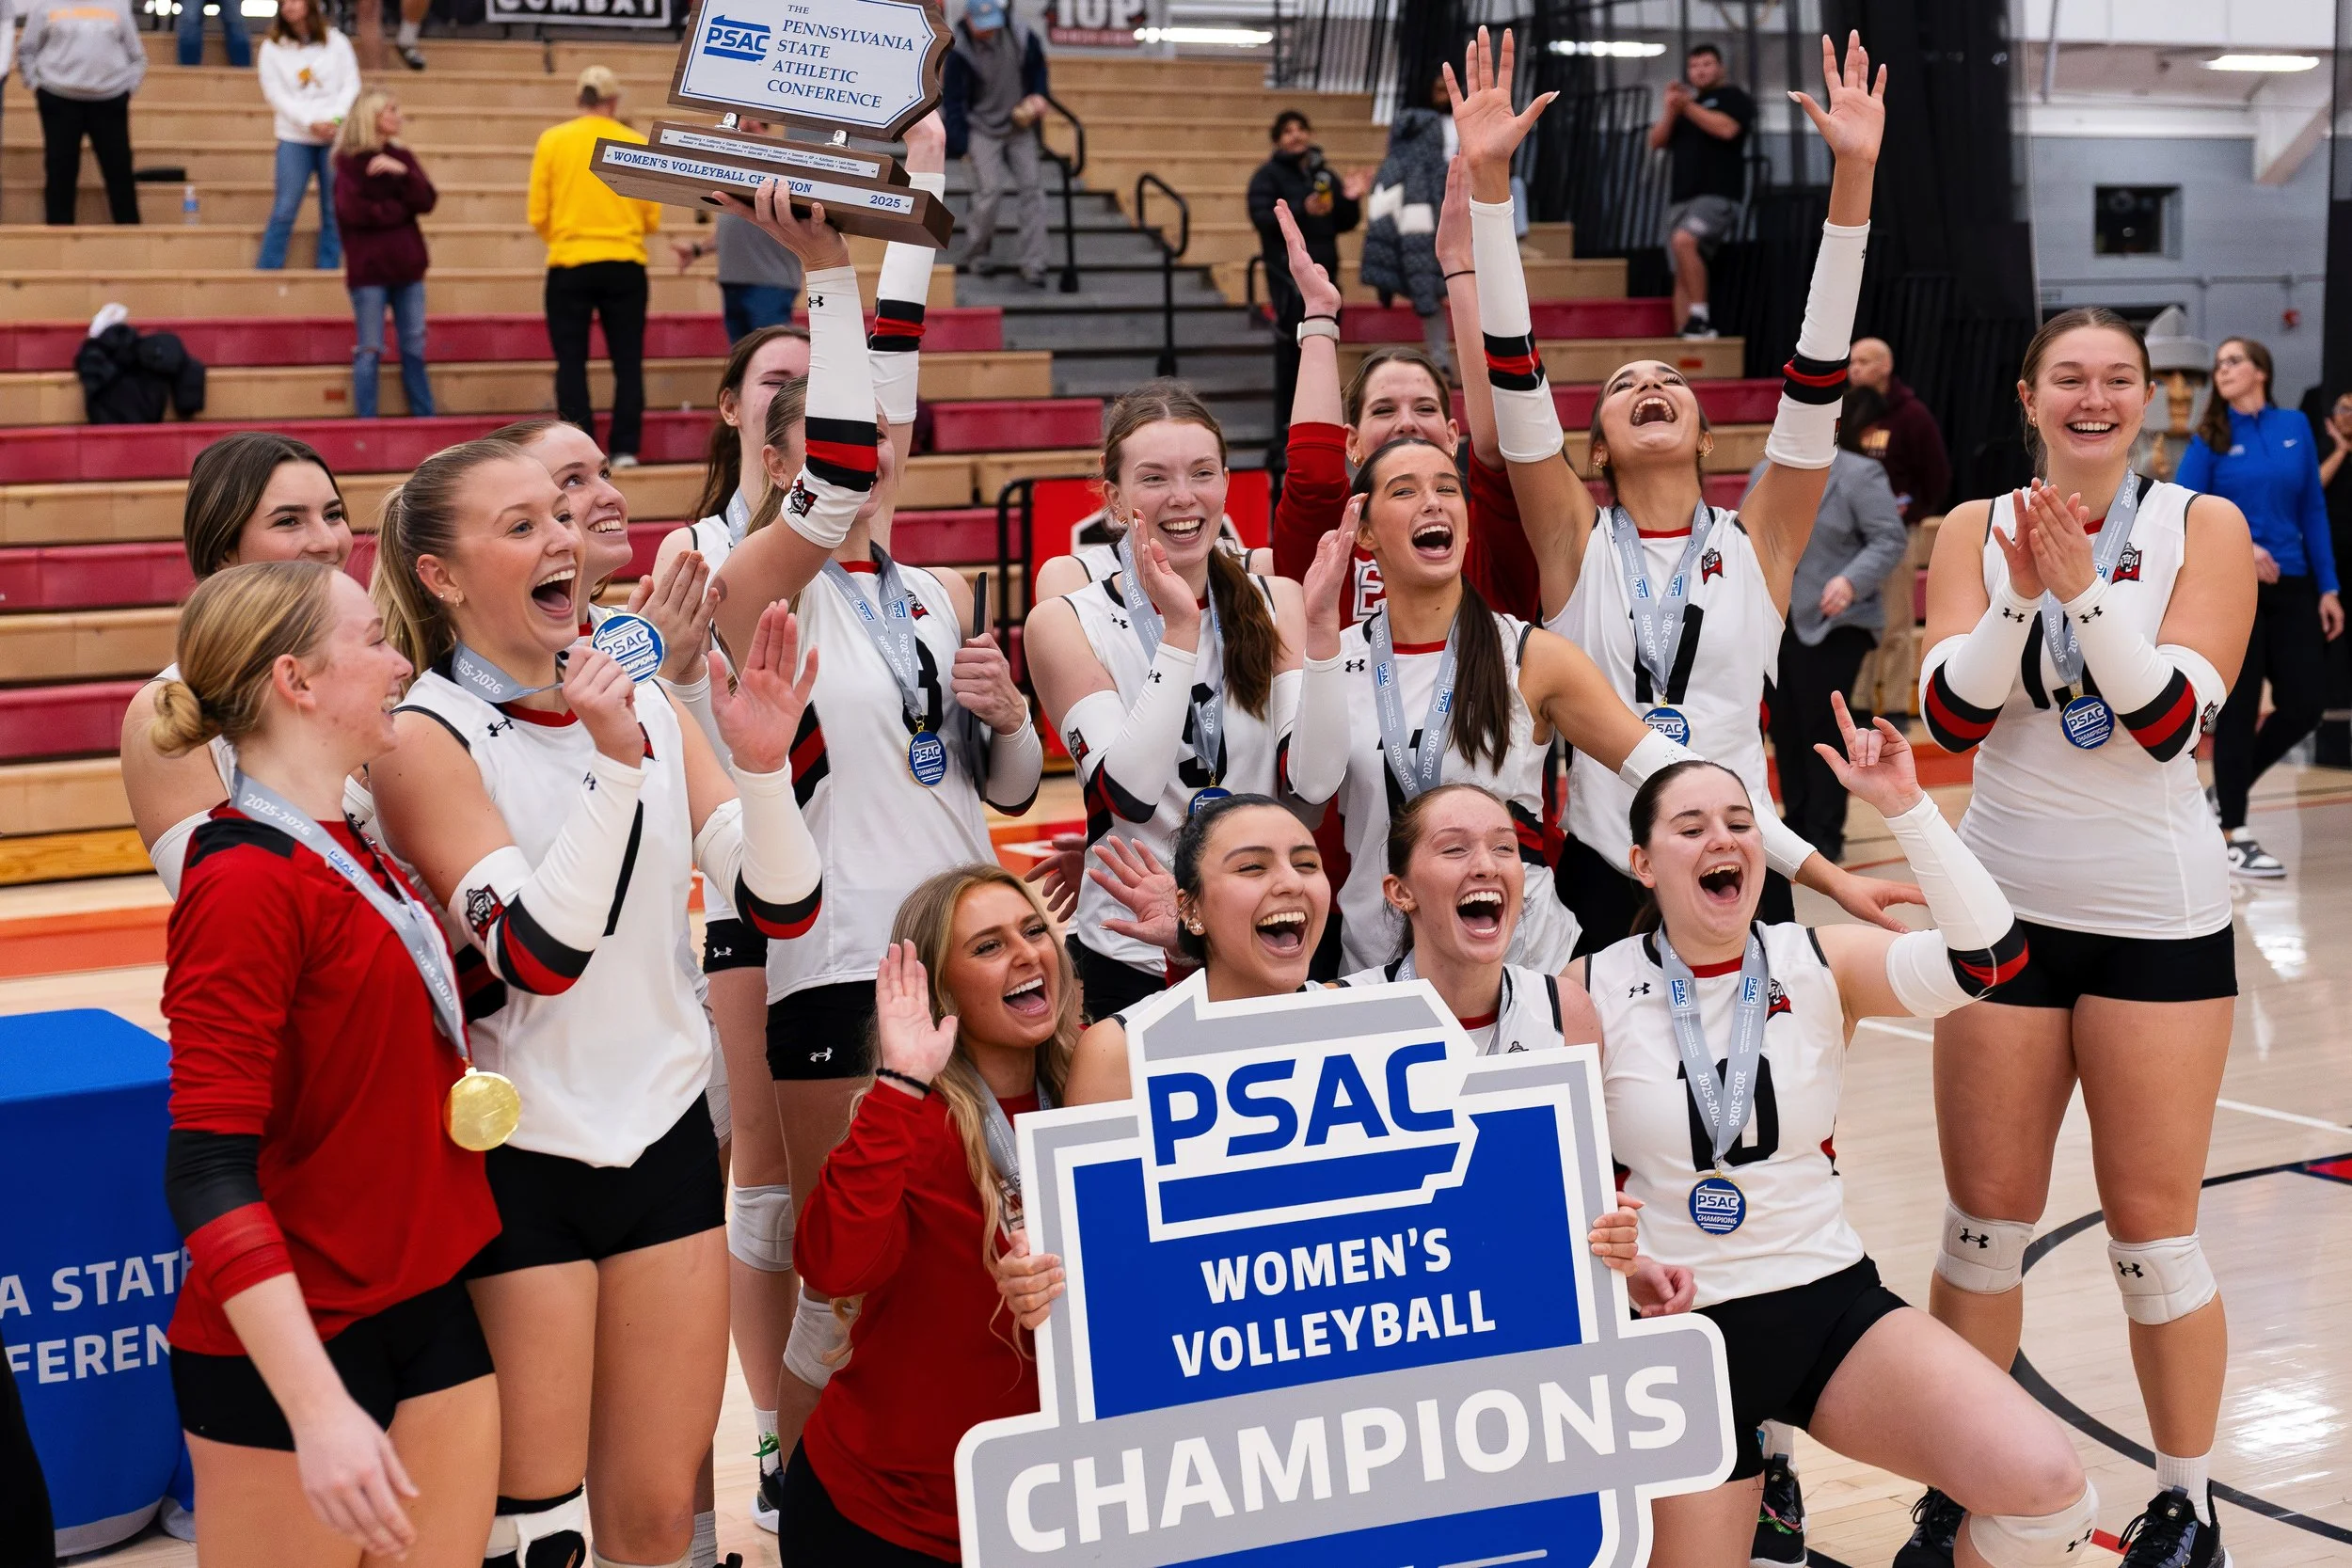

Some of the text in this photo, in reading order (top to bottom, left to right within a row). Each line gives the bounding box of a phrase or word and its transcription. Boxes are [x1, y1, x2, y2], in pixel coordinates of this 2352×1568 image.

[787, 5, 809, 14] THE
[706, 26, 771, 54] PSAC
[782, 19, 914, 51] PENNSYLVANIA
[777, 40, 831, 59] STATE
[771, 59, 859, 84] ATHLETIC
[767, 80, 882, 108] CONFERENCE
[613, 150, 668, 169] WOMEN'S
[671, 161, 745, 182] VOLLEYBALL
[748, 173, 813, 193] CHION
[869, 195, 902, 209] 2025
[1638, 578, 1648, 598] PSAC
[1671, 576, 1681, 596] PSAC
[1642, 614, 1658, 661] 2025-2026
[1661, 612, 1675, 656] 25-2026
[2048, 614, 2067, 663] 2025-2026
[899, 633, 913, 675] 25-2026
[1379, 661, 1390, 688] PSAC
[1438, 689, 1451, 713] PSAC
[2069, 706, 2105, 730] PSAC
[2075, 724, 2110, 743] CHAMPIONS
[914, 746, 941, 762] PSAC
[1391, 741, 1417, 791] 2025-2026
[1422, 729, 1439, 781] 2025-2026
[917, 765, 944, 777] CHAMPIONS
[243, 793, 313, 838] 2025-2026
[1675, 979, 1688, 1006] PSAC
[1747, 977, 1758, 1004] PSAC
[1148, 1041, 1454, 1165] PSAC
[1728, 1070, 1746, 1127] 2025-2026
[1697, 1195, 1738, 1209] PSAC
[1697, 1213, 1738, 1225] CHAMPIONS
[1200, 1227, 1453, 1305] WOMEN'S
[1171, 1290, 1496, 1377] VOLLEYBALL
[1006, 1366, 1687, 1553] CHAMPIONS
